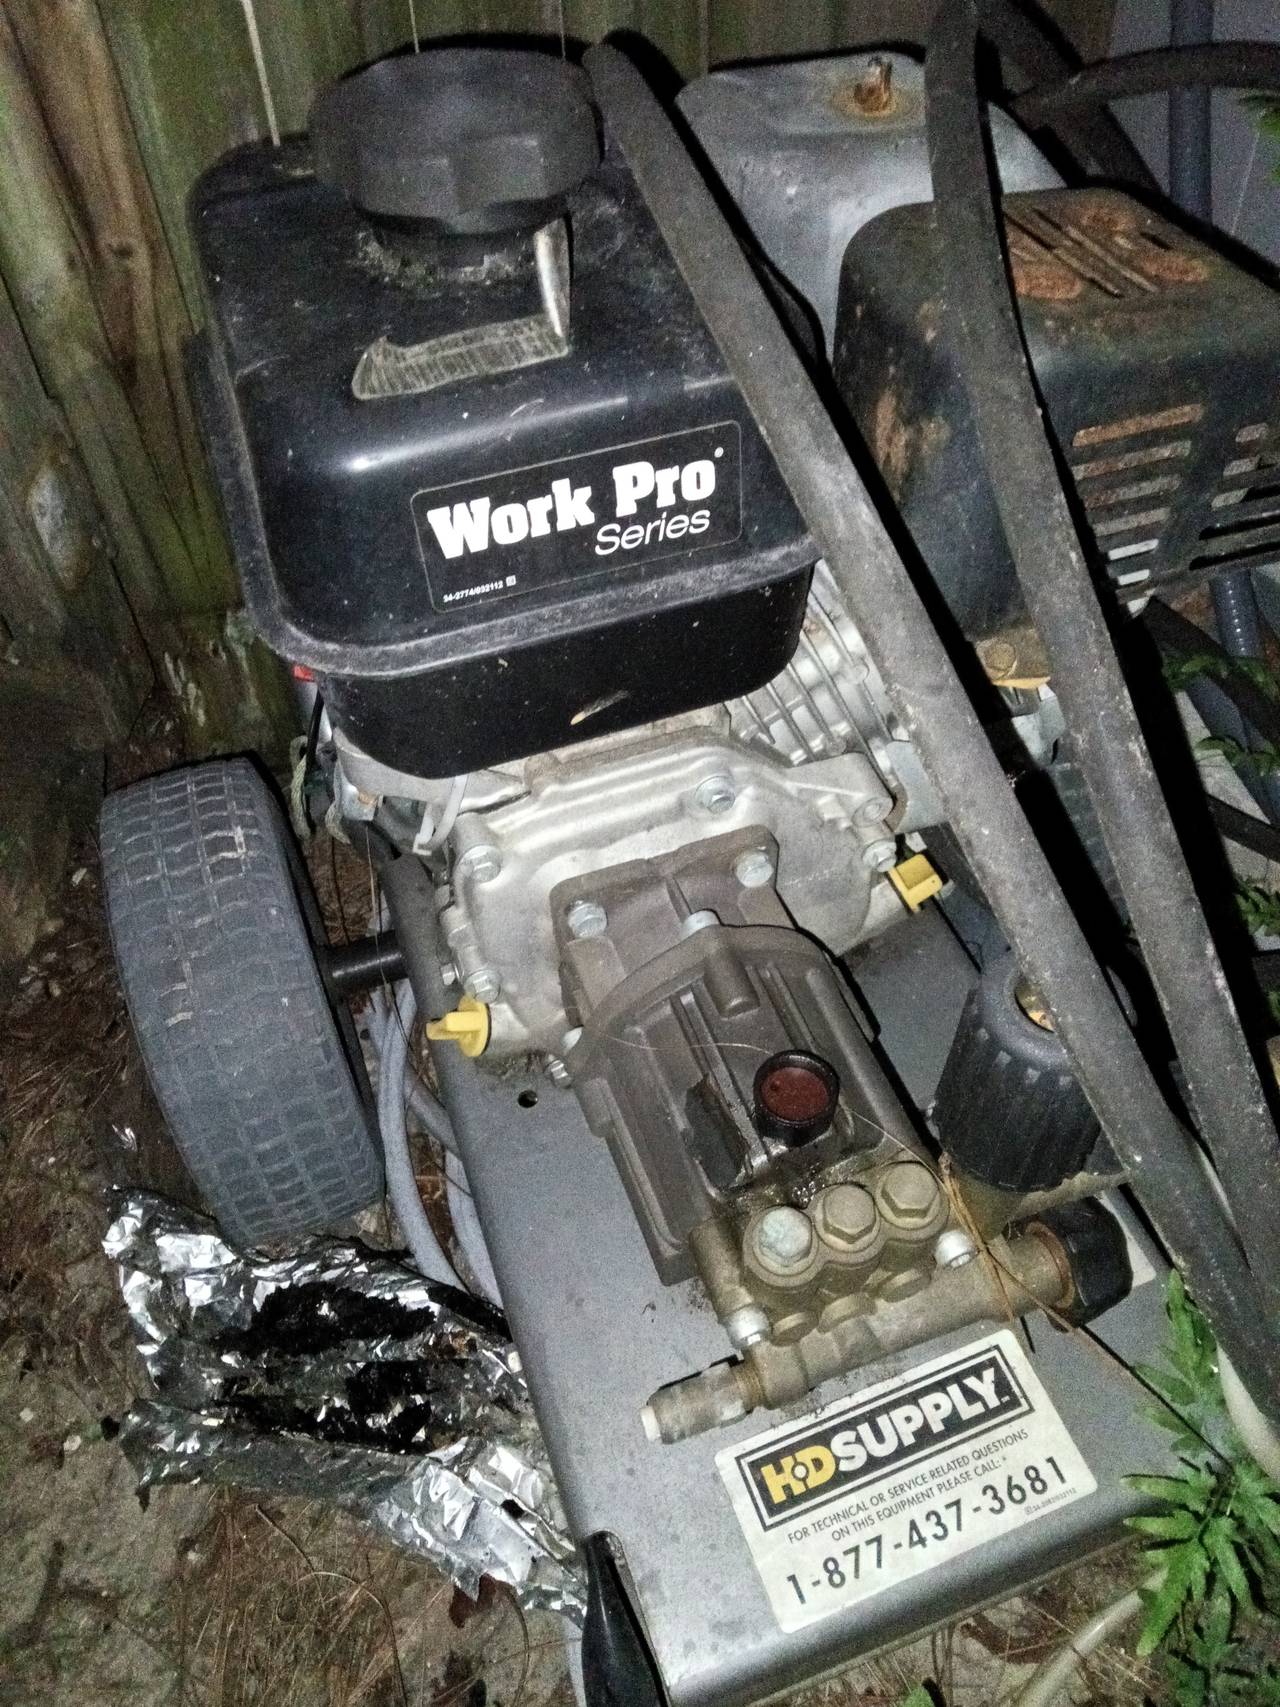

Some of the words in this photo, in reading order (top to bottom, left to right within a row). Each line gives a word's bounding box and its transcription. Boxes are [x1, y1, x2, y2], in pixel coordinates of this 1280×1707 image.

[427, 478, 595, 559] Work
[612, 459, 716, 518] Pro
[595, 508, 711, 556] Series
[786, 1455, 1069, 1605] 1-877-437-3681
[787, 1526, 811, 1544] FOR
[811, 1500, 870, 1533] TECHNICAL
[870, 1492, 886, 1507] OR
[887, 1473, 929, 1500] SERVICE
[929, 1455, 970, 1481] RELATED
[971, 1428, 1029, 1461] QUESTIONS
[831, 1525, 851, 1541] ON
[851, 1513, 875, 1533] THIS
[876, 1487, 936, 1521] EQUIPMENT
[936, 1470, 973, 1495] PLEASE
